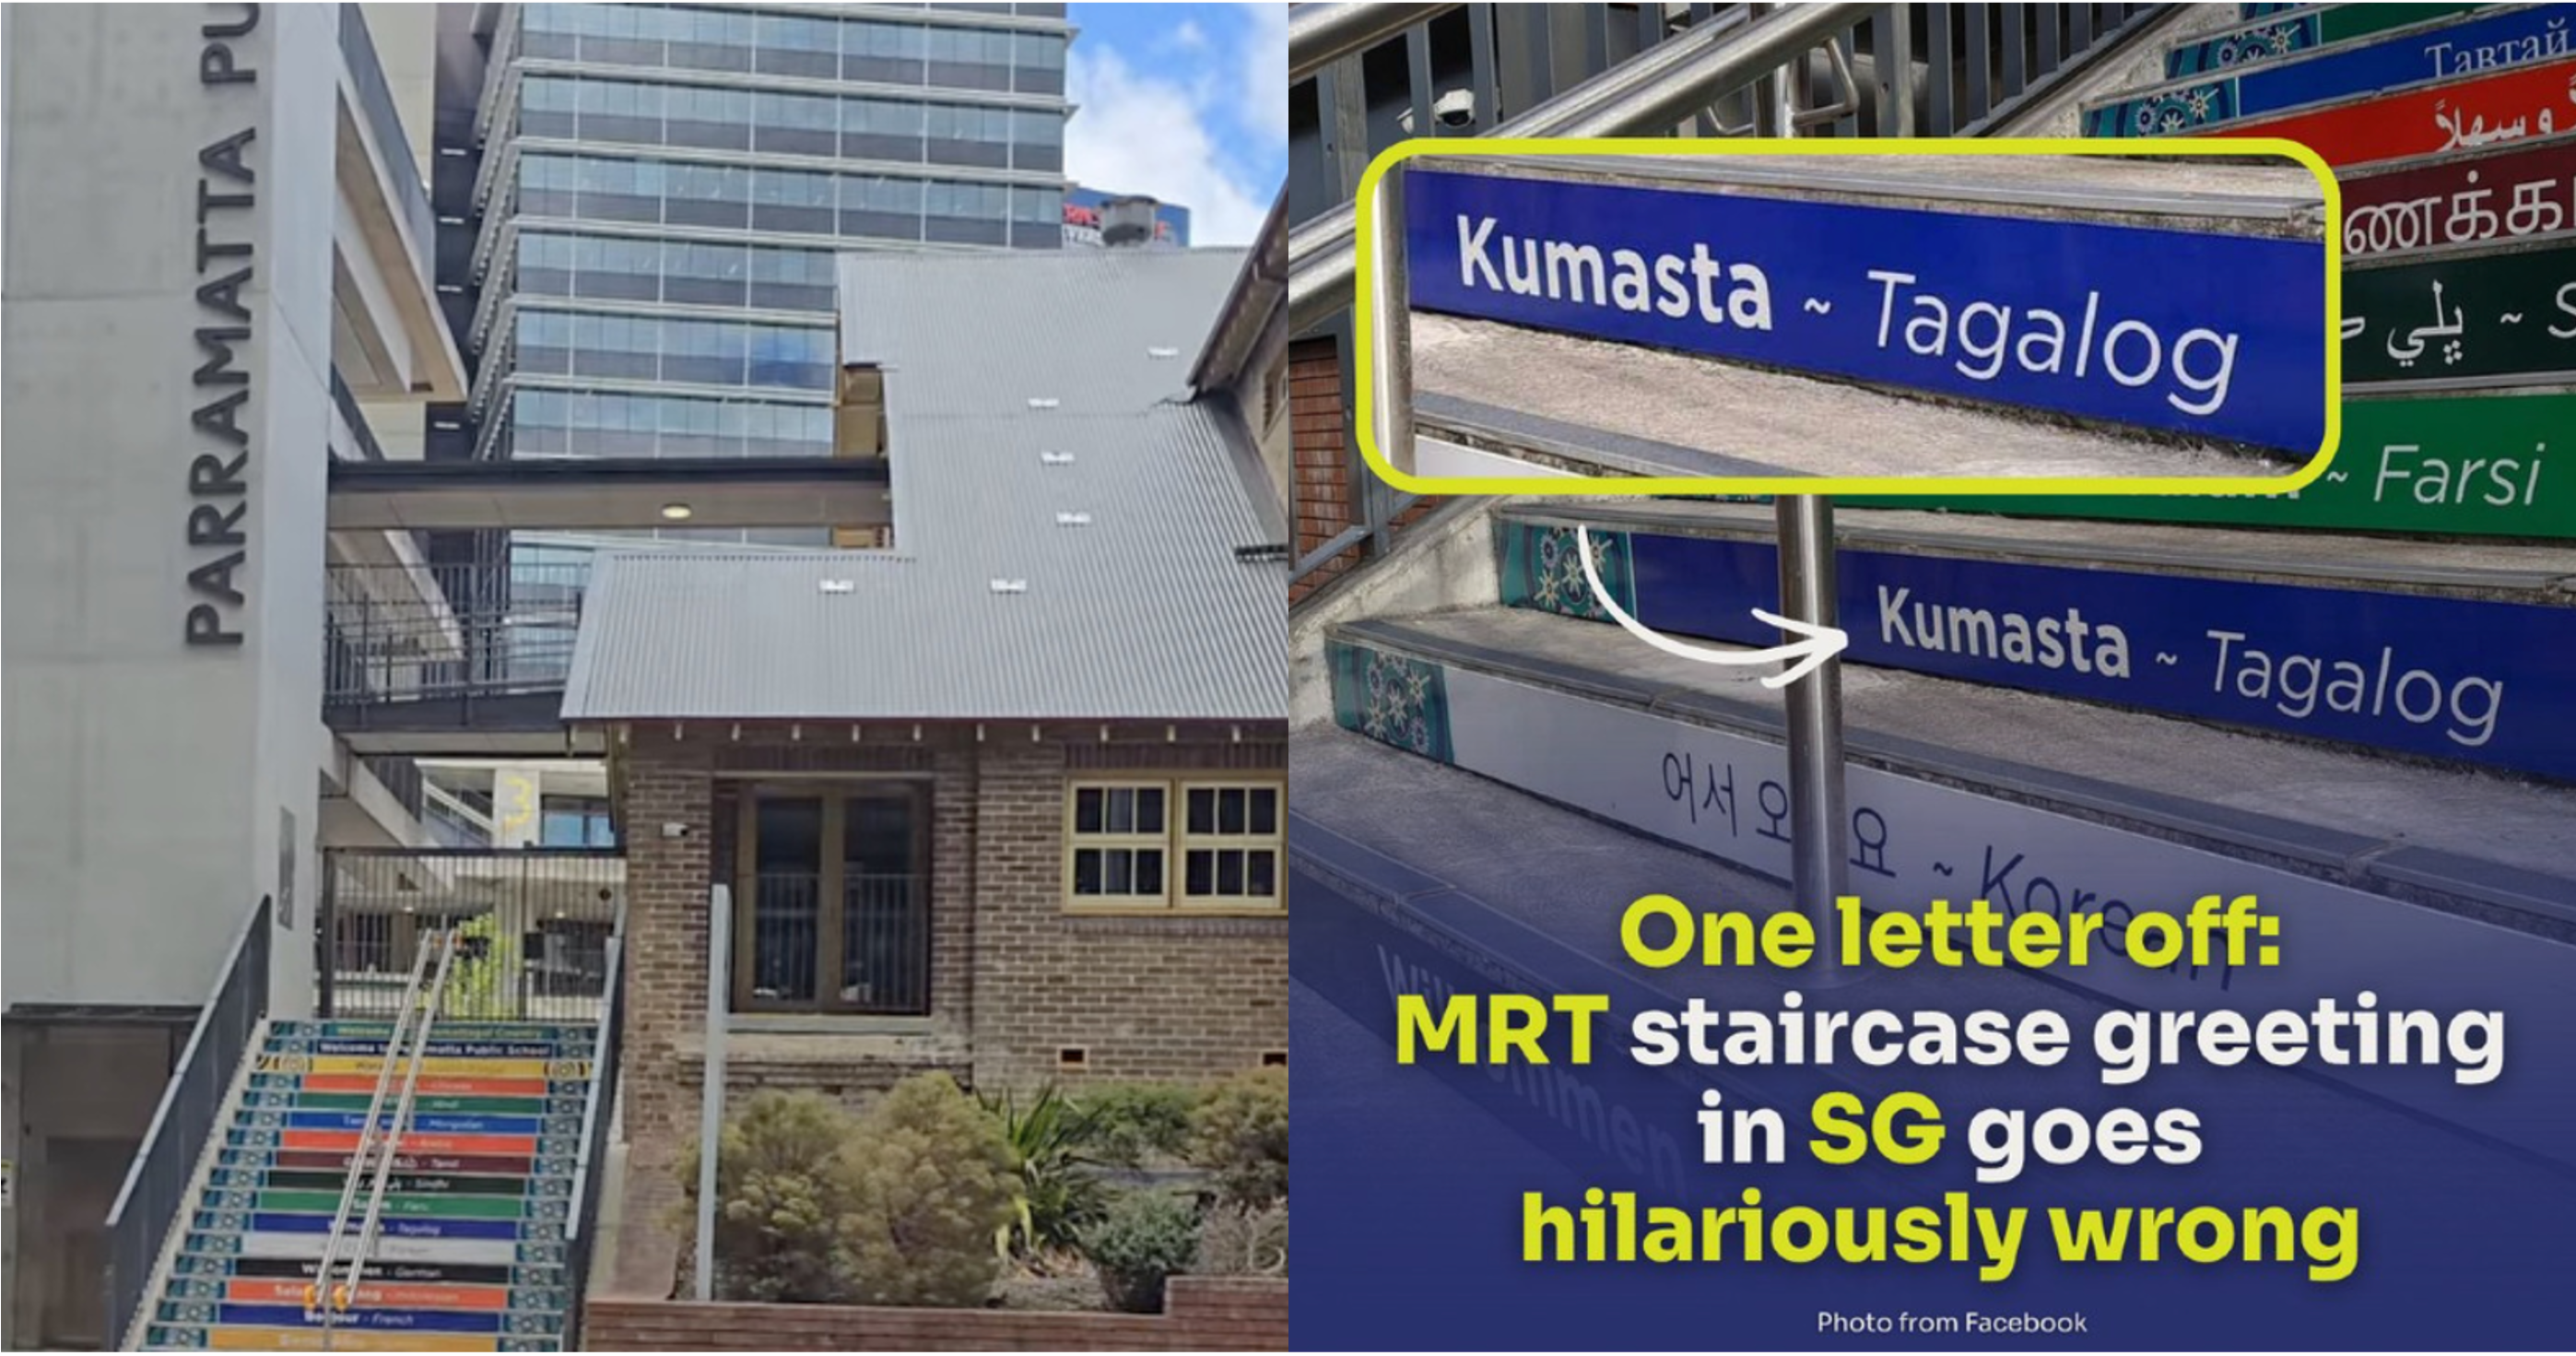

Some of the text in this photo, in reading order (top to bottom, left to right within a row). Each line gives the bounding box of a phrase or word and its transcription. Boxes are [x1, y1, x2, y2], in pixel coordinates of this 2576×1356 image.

[2344, 170, 2576, 254] ணக்க
[186, 126, 256, 647] PARRAMATTA
[1456, 213, 1773, 332] Kumasta
[1867, 269, 2241, 416] Tagalog
[2373, 442, 2546, 506] Farsi
[1878, 585, 2131, 679] Kumasta
[2205, 630, 2504, 748] Tagalog
[1663, 752, 1737, 838] 어서
[1756, 780, 1897, 878] 오요
[1981, 843, 2234, 993] Kore
[371, 1313, 415, 1326] French
